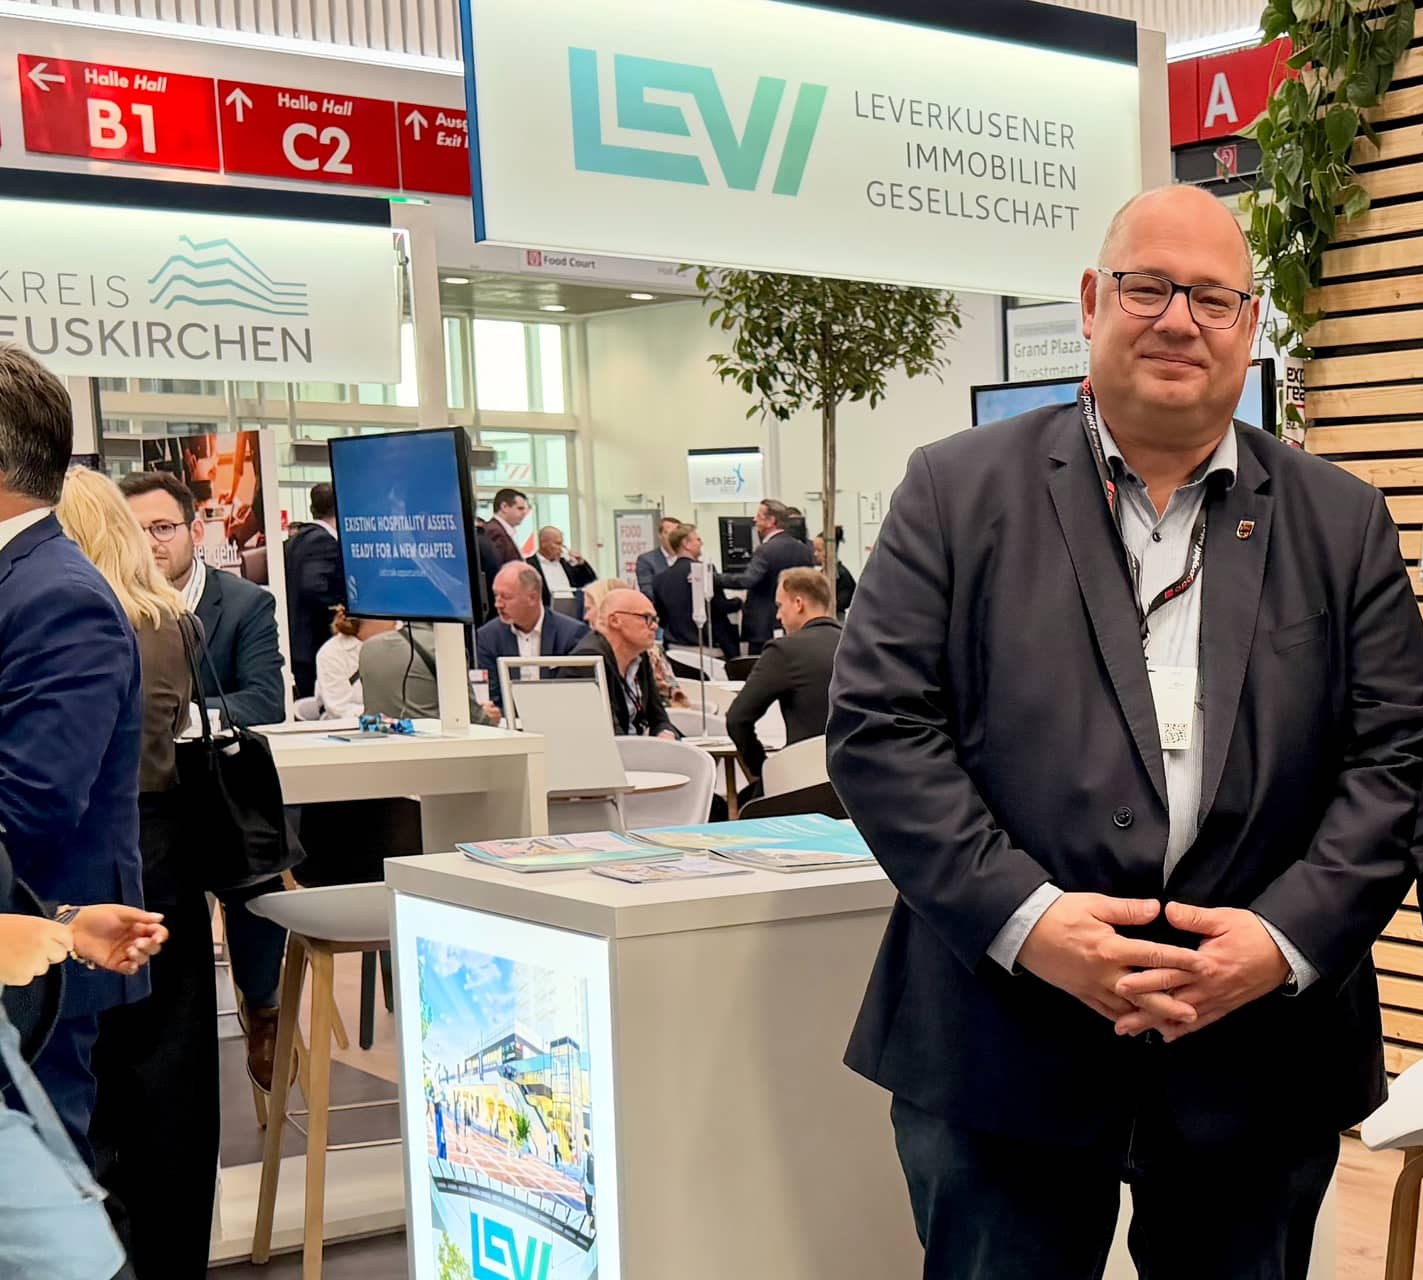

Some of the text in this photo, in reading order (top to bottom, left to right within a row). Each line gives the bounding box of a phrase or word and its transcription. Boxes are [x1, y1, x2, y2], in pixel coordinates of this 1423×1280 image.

[85, 68, 167, 93] Halle Hall
[278, 92, 353, 117] Halle Hall
[1204, 72, 1239, 128] A
[87, 98, 157, 154] B1
[568, 46, 828, 197] LEVI
[854, 90, 1076, 150] LEVERKUSENER
[282, 122, 353, 175] C2
[437, 131, 462, 148] Exit
[906, 142, 1077, 191] IMMOBILIEN
[866, 180, 1080, 231] GESELLSCHAFT
[544, 255, 596, 269] Food Court
[1014, 339, 1048, 358] Grand
[1051, 338, 1081, 355] Plaza
[344, 514, 457, 532] EXISTING HOSPITALITY ASSETS.
[351, 542, 456, 559] READY FOR A NEW CHAPTER.
